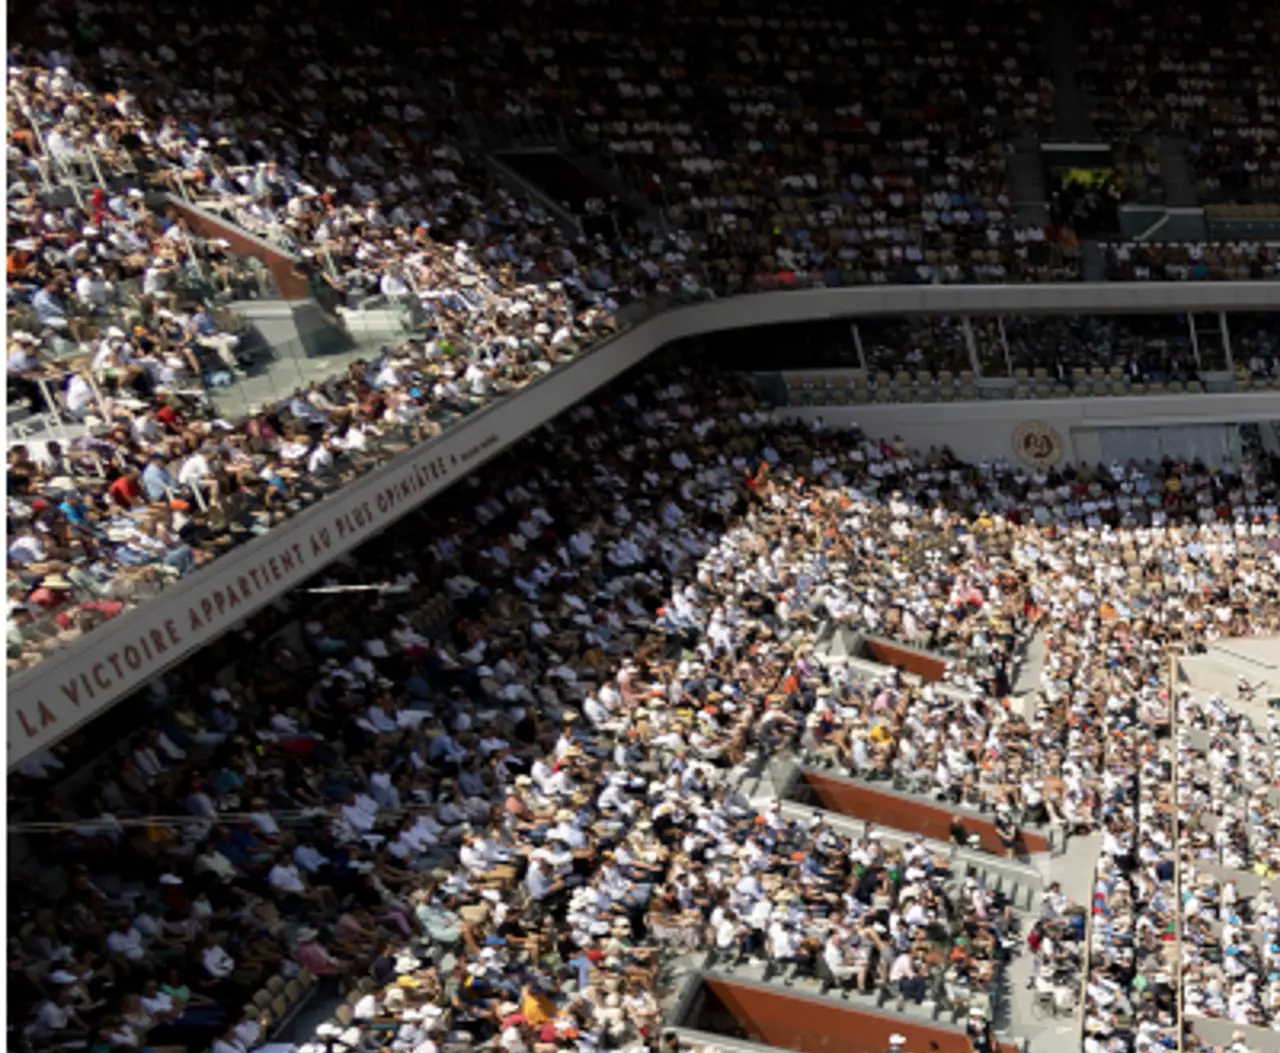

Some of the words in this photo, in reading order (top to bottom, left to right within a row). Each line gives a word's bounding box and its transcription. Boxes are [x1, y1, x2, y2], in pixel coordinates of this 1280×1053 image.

[16, 700, 57, 738] LA
[60, 618, 182, 707] VICTOIRE
[189, 542, 304, 630] APPARTIENT
[310, 527, 331, 557] AU
[335, 502, 373, 538] PLUS
